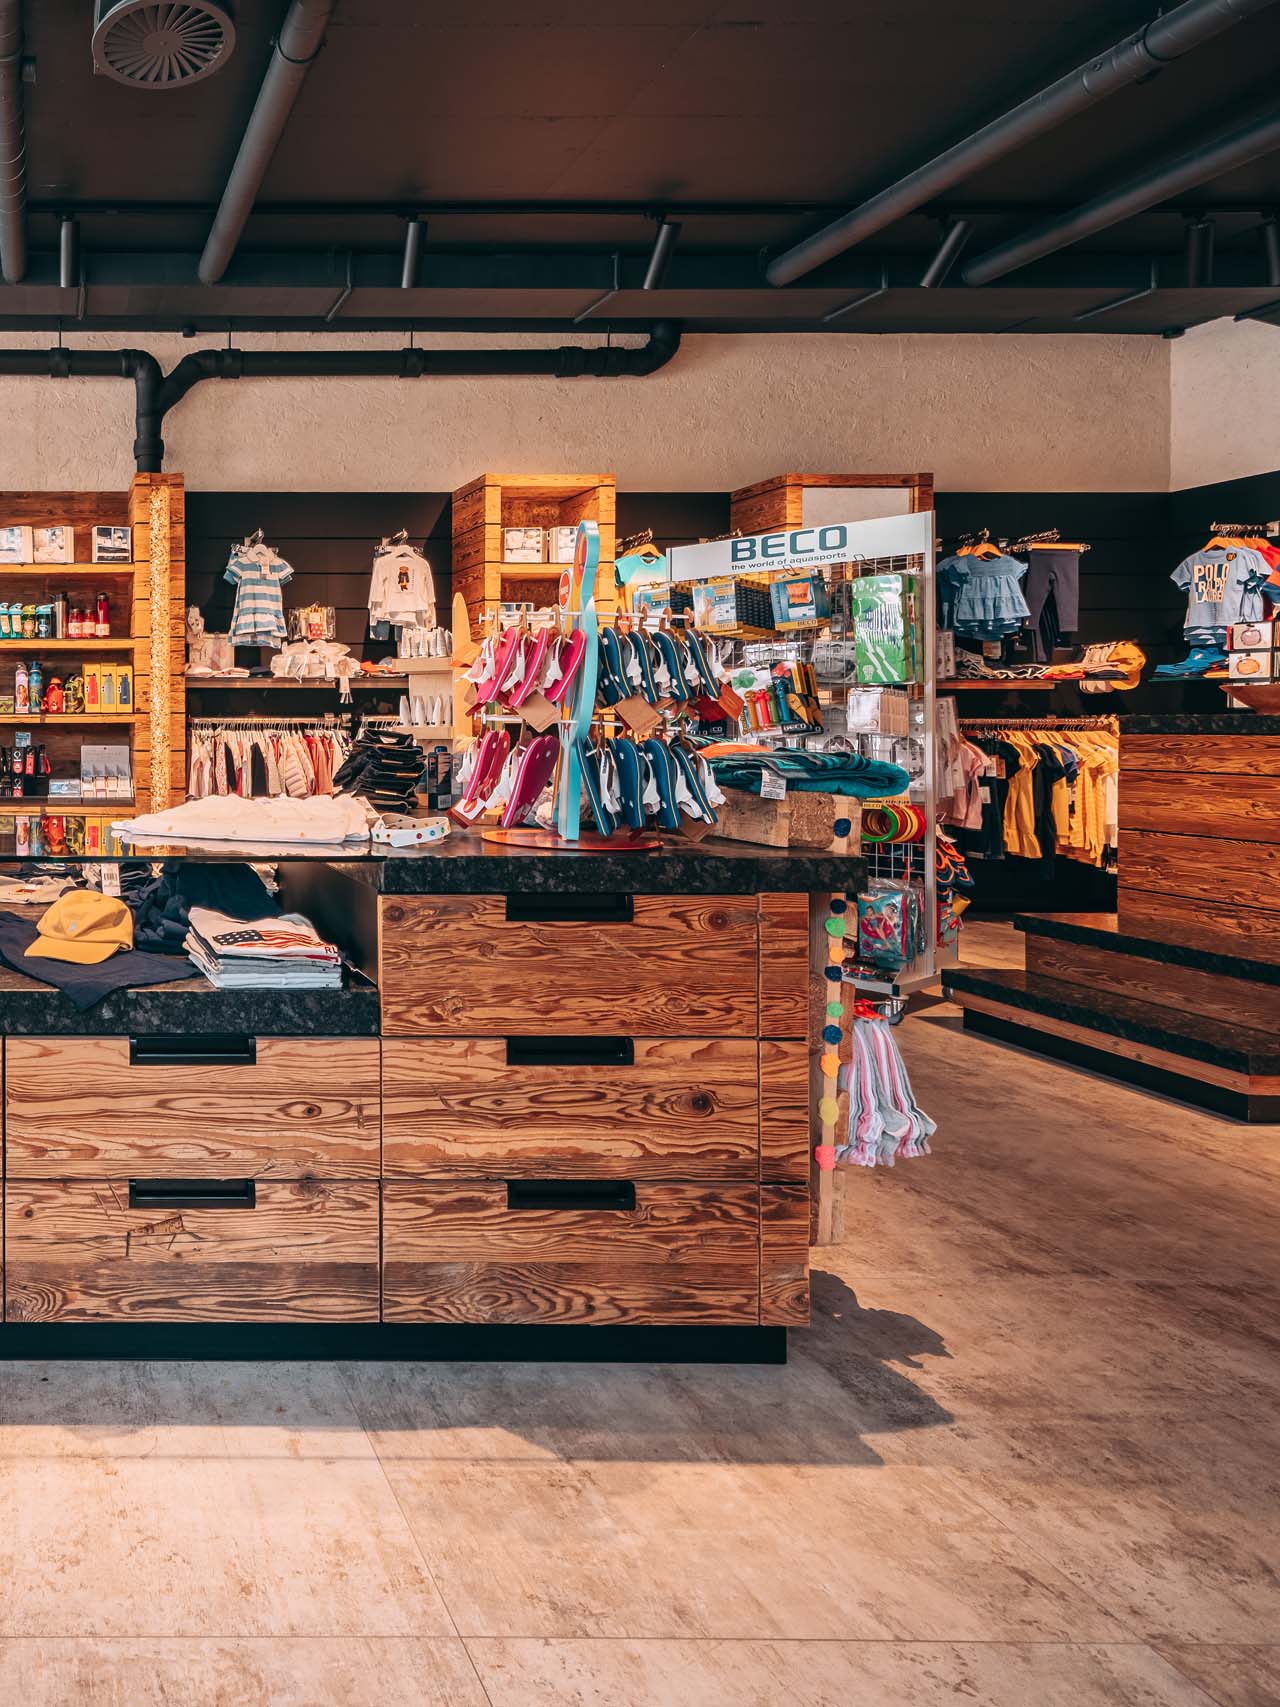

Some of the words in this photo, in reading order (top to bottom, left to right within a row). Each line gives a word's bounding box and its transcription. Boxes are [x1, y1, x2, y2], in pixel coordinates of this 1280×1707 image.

[731, 525, 848, 563] BECO
[731, 563, 746, 571] the
[748, 560, 775, 569] world
[777, 557, 787, 566] of
[789, 552, 847, 567] aquasports
[1194, 563, 1230, 583] POLO
